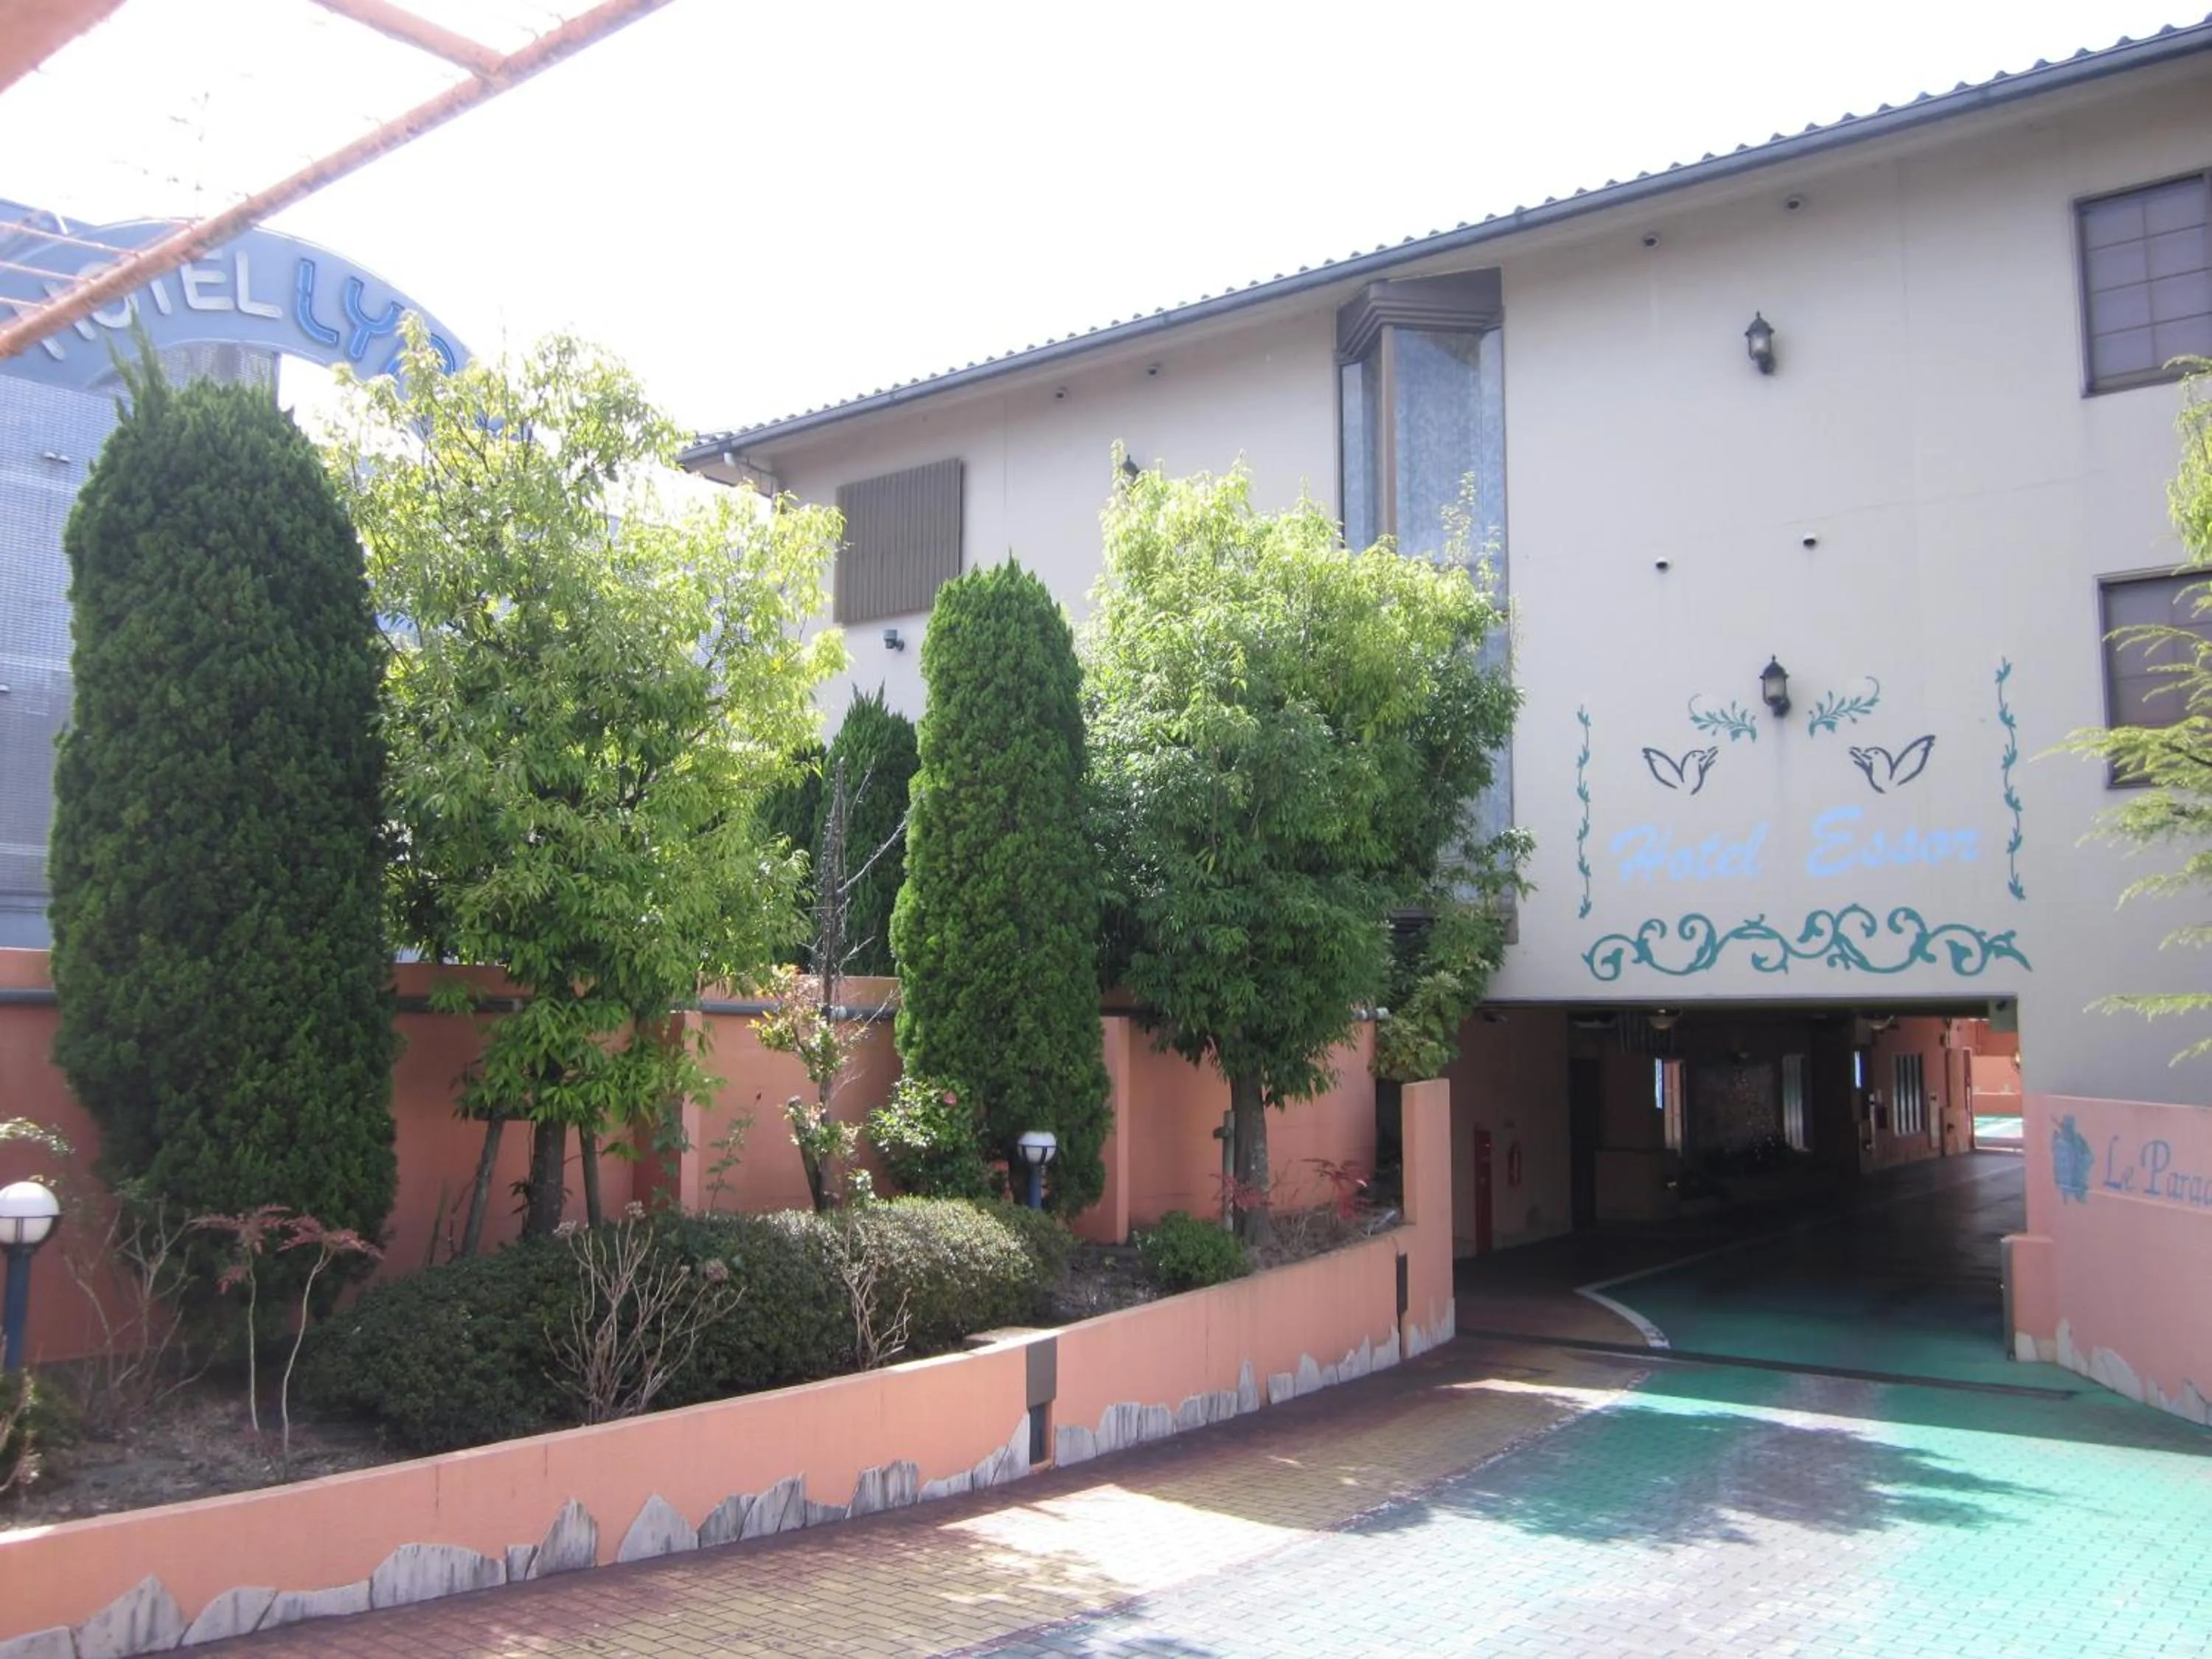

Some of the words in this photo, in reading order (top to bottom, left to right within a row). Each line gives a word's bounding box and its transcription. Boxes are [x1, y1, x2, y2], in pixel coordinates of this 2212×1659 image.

[1609, 821, 1770, 883] Hotel
[1806, 806, 1980, 877] Essor
[2102, 1135, 2135, 1193] Le
